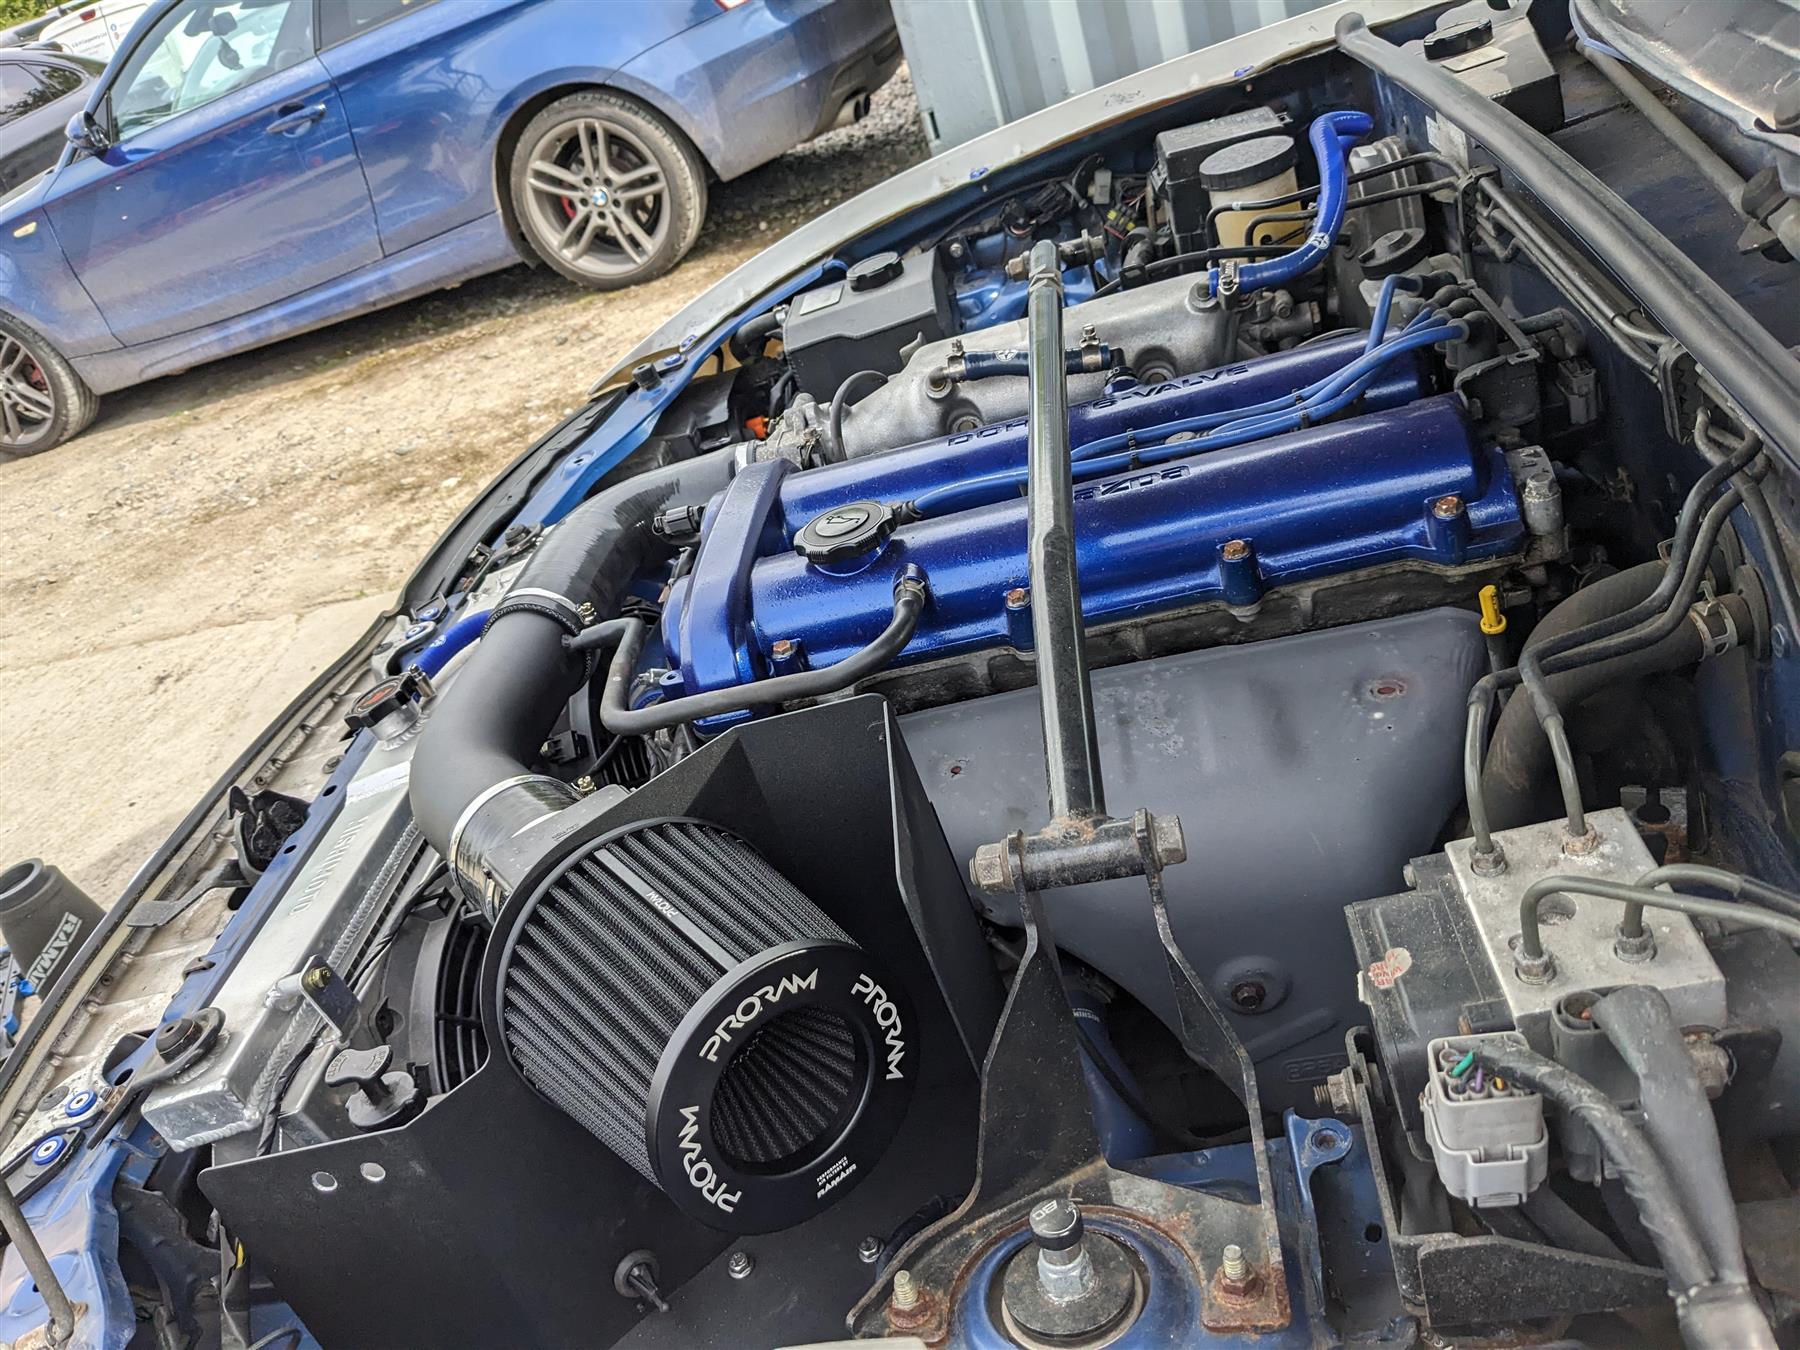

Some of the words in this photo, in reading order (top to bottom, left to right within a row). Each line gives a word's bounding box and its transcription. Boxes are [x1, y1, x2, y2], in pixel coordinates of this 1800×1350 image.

[947, 419, 1029, 447] DOH
[1073, 465, 1191, 503] azda
[27, 912, 82, 993] RAMAI
[699, 967, 819, 1063] PRORAM
[850, 973, 906, 1080] PRORAM
[678, 1105, 743, 1214] PRORAM
[816, 1156, 848, 1182] PERFORMANCE
[816, 1163, 857, 1199] RAMAIR
[1032, 1199, 1058, 1220] BC
